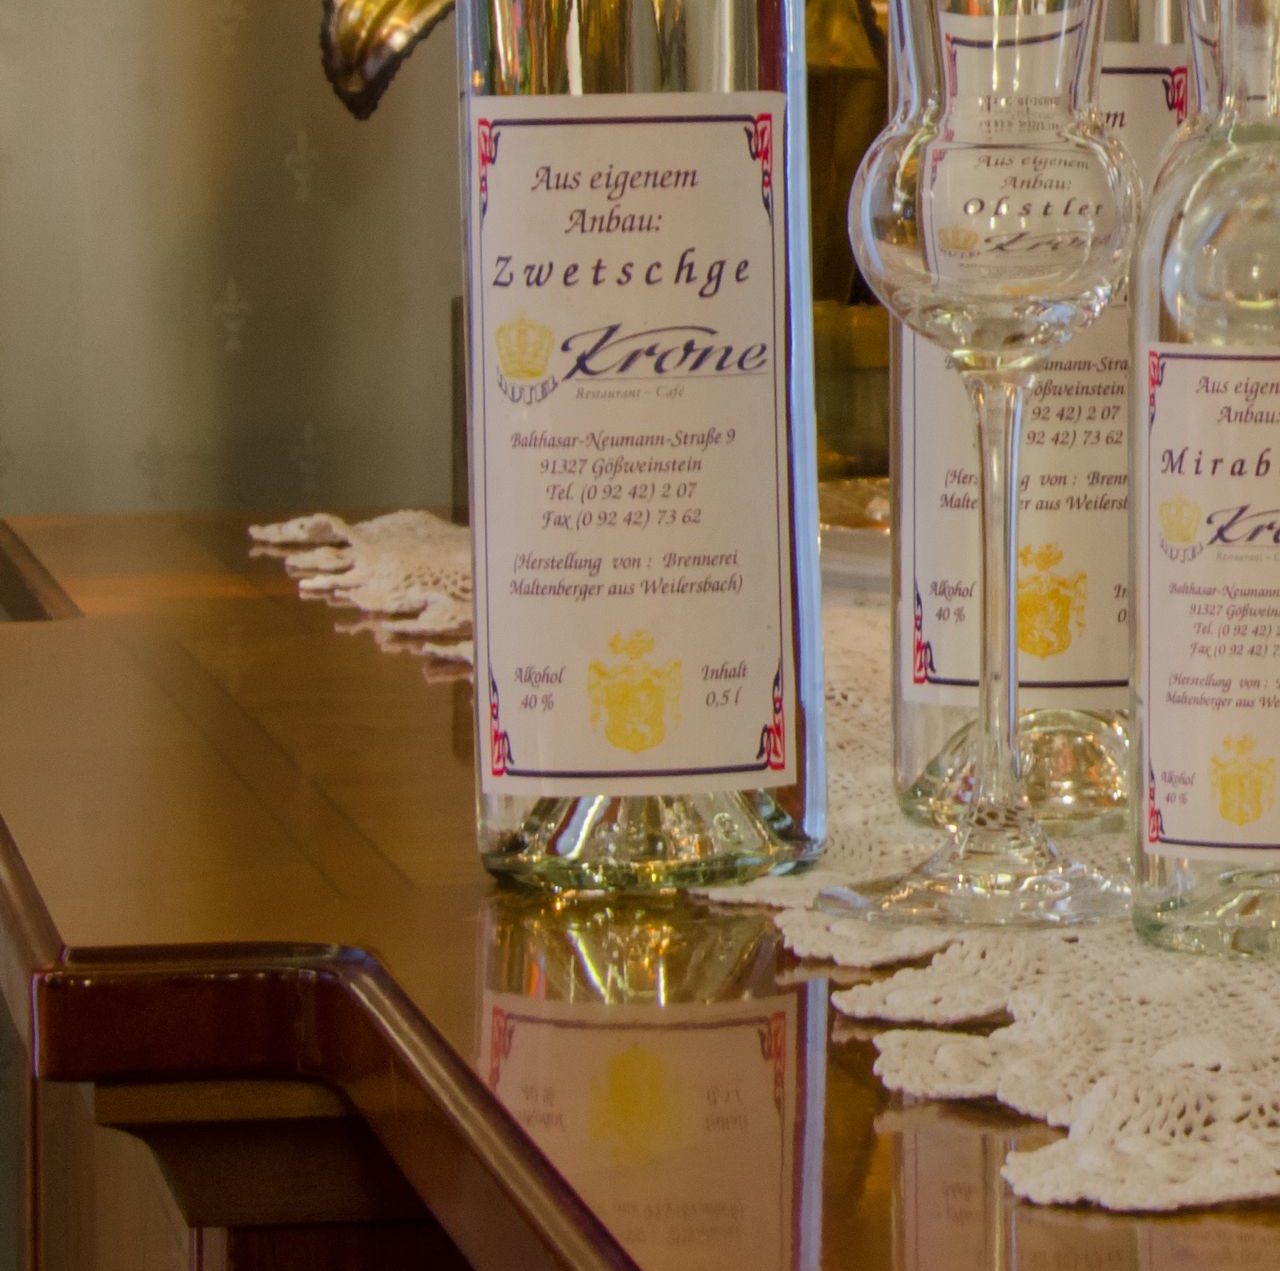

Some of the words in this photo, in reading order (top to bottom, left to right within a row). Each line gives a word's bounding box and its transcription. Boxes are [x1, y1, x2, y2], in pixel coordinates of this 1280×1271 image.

[530, 165, 582, 192] Aus
[589, 163, 699, 202] eigenem
[564, 203, 663, 235] Anbau:
[492, 247, 750, 299] Zwetschge
[560, 322, 769, 382] Krone
[1025, 381, 1125, 401] ößweinstein
[1195, 375, 1229, 395] Aus
[540, 457, 589, 476] 91327
[591, 455, 703, 481] Gößweinstein
[545, 481, 574, 502] Tel.
[580, 484, 598, 505] (0
[601, 484, 623, 501] 92
[627, 482, 656, 501] 42)
[660, 482, 672, 500] 2
[675, 481, 698, 499] 07
[542, 510, 572, 531] Fax
[575, 511, 594, 532] (0
[597, 510, 618, 528] 92
[622, 508, 651, 529] 42)
[657, 508, 677, 526] 73
[681, 508, 702, 525] 62
[612, 556, 642, 570] von
[662, 550, 738, 569] Brennerei
[509, 578, 605, 602] Maltenberger
[607, 583, 635, 597] aus
[639, 573, 744, 595] Weilersbach)
[513, 665, 566, 689] Alkohol
[701, 661, 748, 681] Inhalt
[520, 694, 538, 710] 40
[705, 688, 731, 708] 0,5
